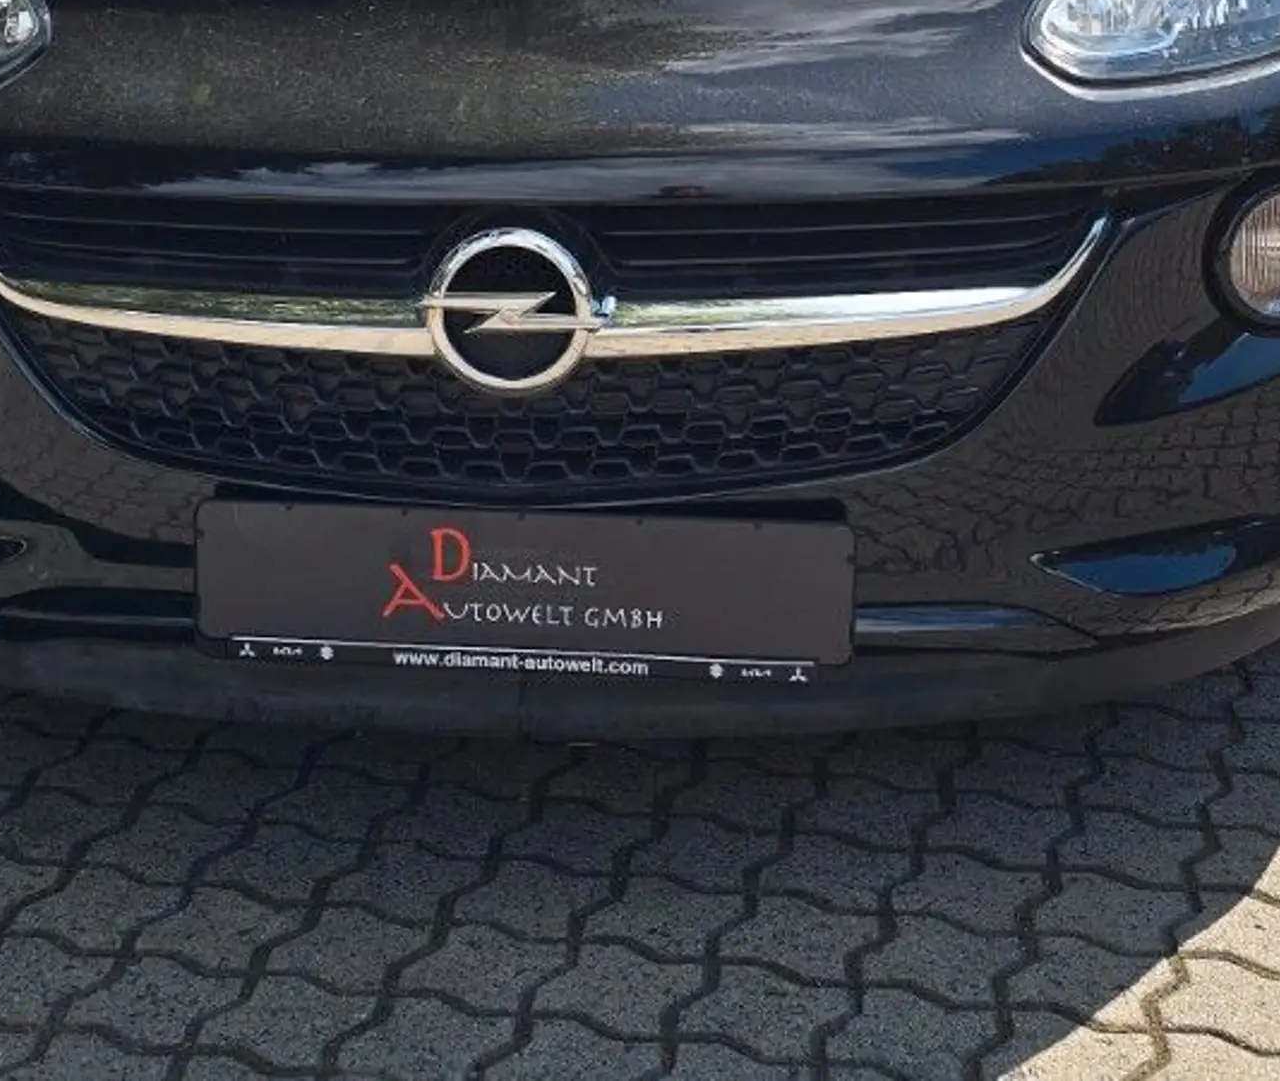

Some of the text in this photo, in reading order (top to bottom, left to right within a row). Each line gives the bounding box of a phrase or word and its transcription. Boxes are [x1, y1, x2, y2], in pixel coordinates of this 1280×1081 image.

[430, 527, 598, 587] DIAMANT
[382, 563, 574, 627] AUTOWELT
[392, 649, 650, 677] www.diamant-autowelt.com
